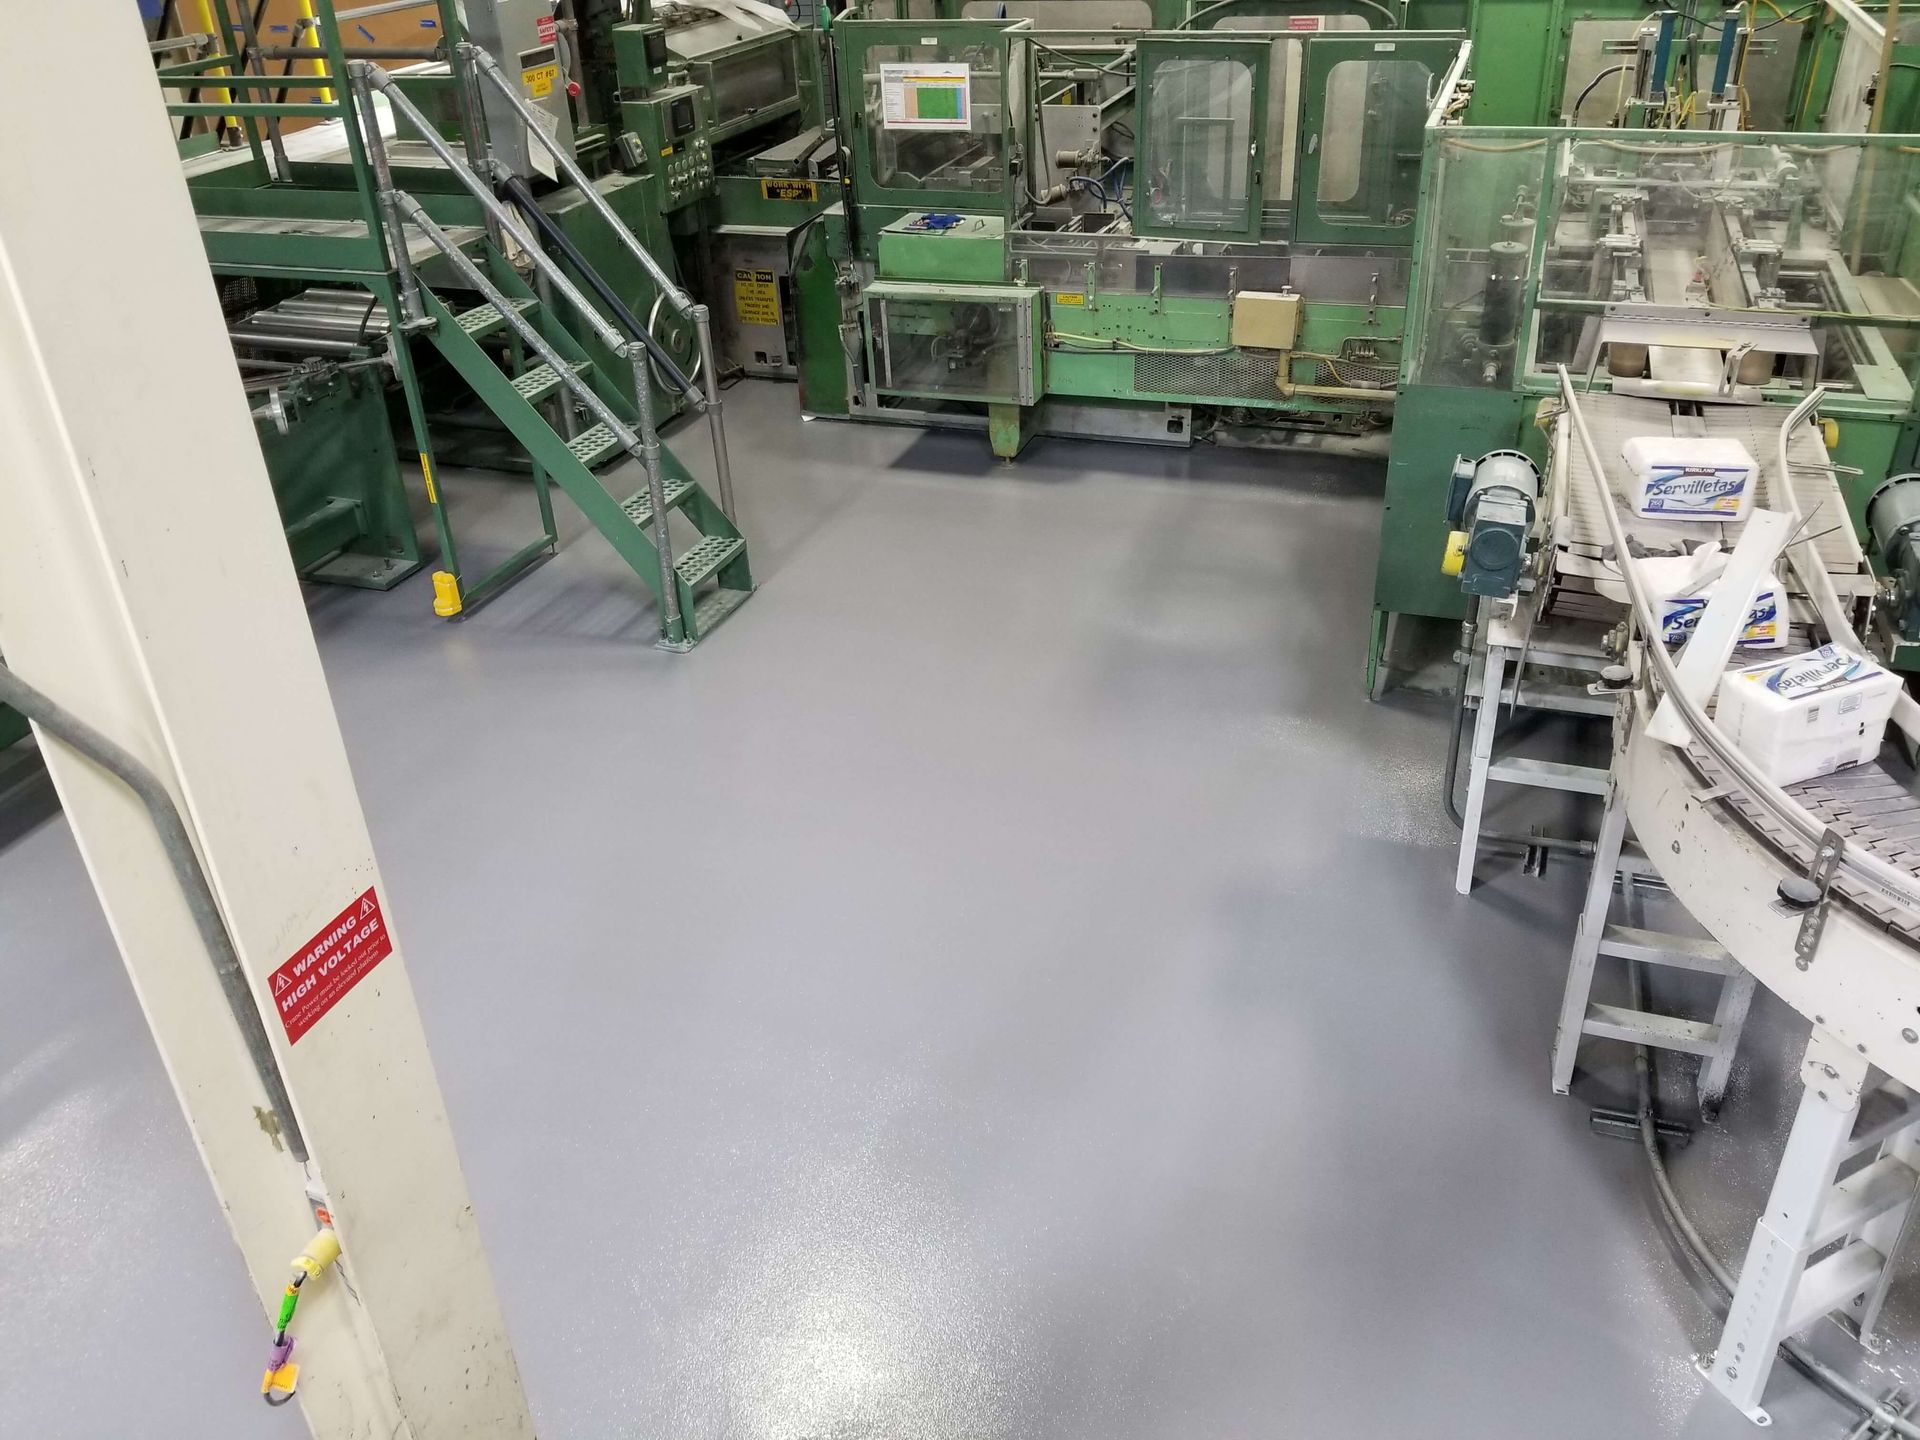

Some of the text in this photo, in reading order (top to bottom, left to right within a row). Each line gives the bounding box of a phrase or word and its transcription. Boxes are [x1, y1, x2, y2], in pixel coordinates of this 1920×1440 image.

[790, 181, 811, 189] WITH
[1652, 479, 1737, 496] Servilletas
[1777, 657, 1848, 691] Servilletas
[281, 917, 379, 1013] HIGH VOLTAGE
[292, 916, 357, 977] WARNING
[285, 933, 386, 1028] Crane Power must be locked out prior to
[298, 950, 379, 1026] working on an elevated platform
